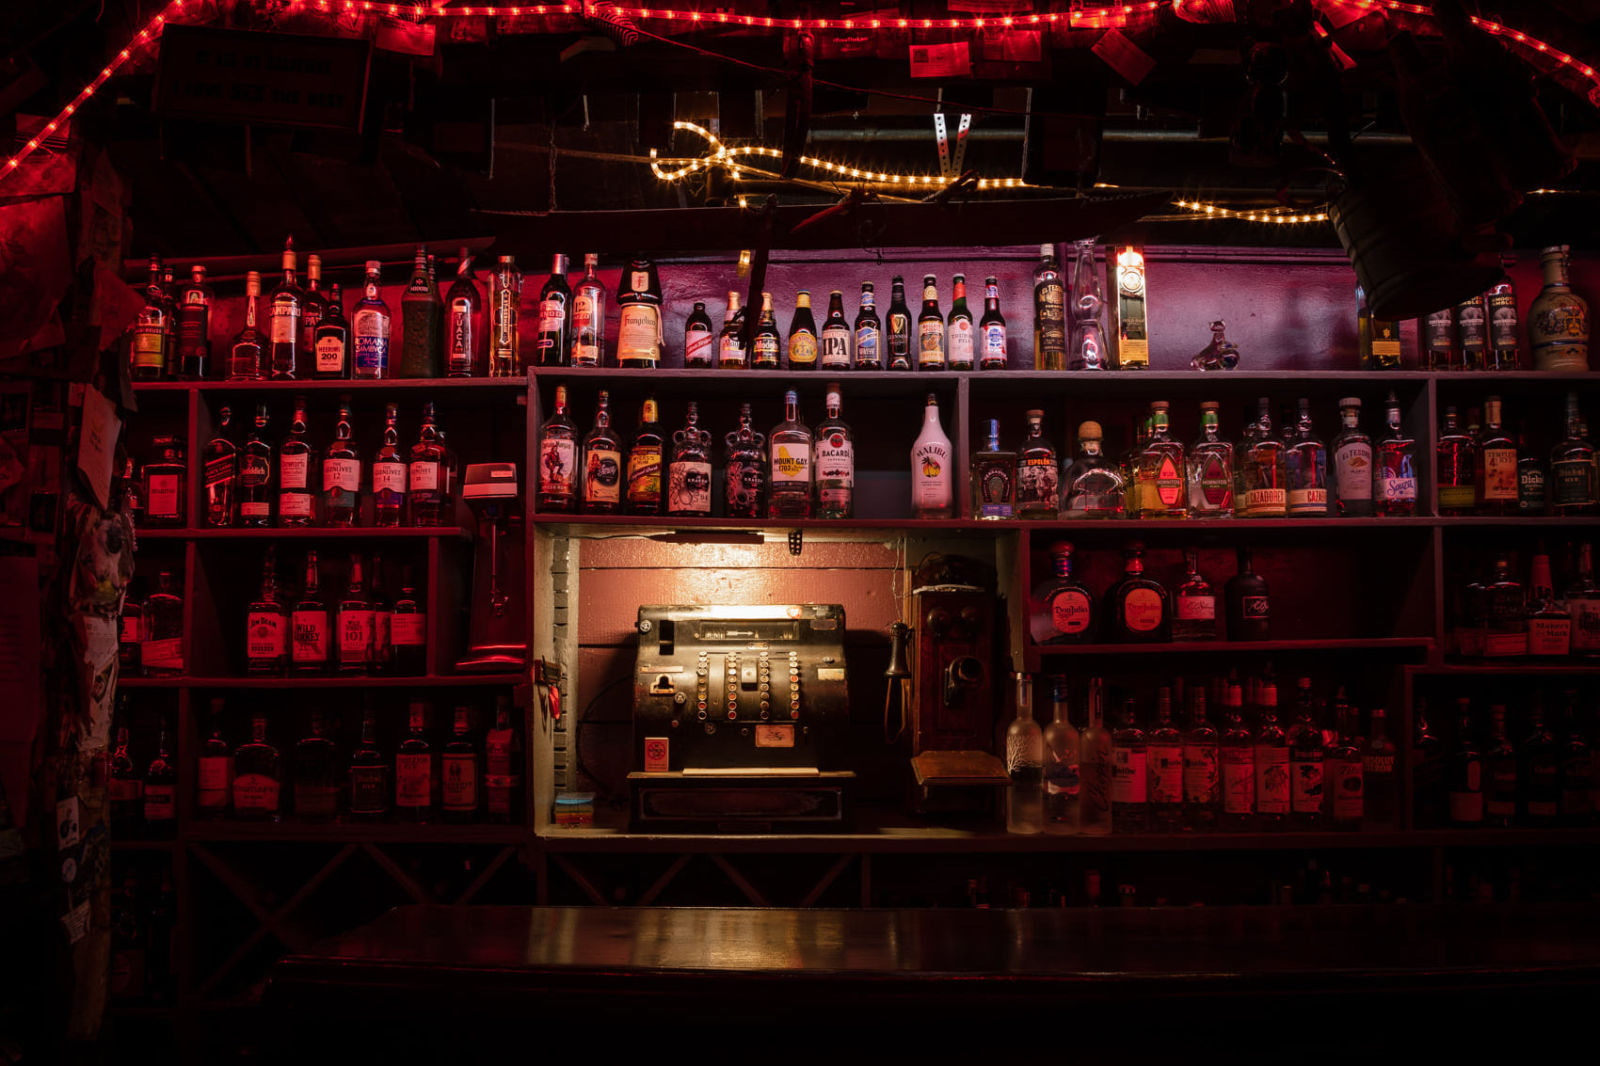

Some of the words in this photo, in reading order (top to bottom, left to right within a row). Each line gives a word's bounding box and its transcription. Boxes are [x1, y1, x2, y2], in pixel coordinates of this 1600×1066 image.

[576, 301, 586, 312] 12
[623, 314, 657, 327] Frangelico
[455, 312, 463, 347] TUACA
[823, 338, 847, 356] IPA
[774, 457, 795, 465] MOUNT
[796, 457, 808, 465] GAY
